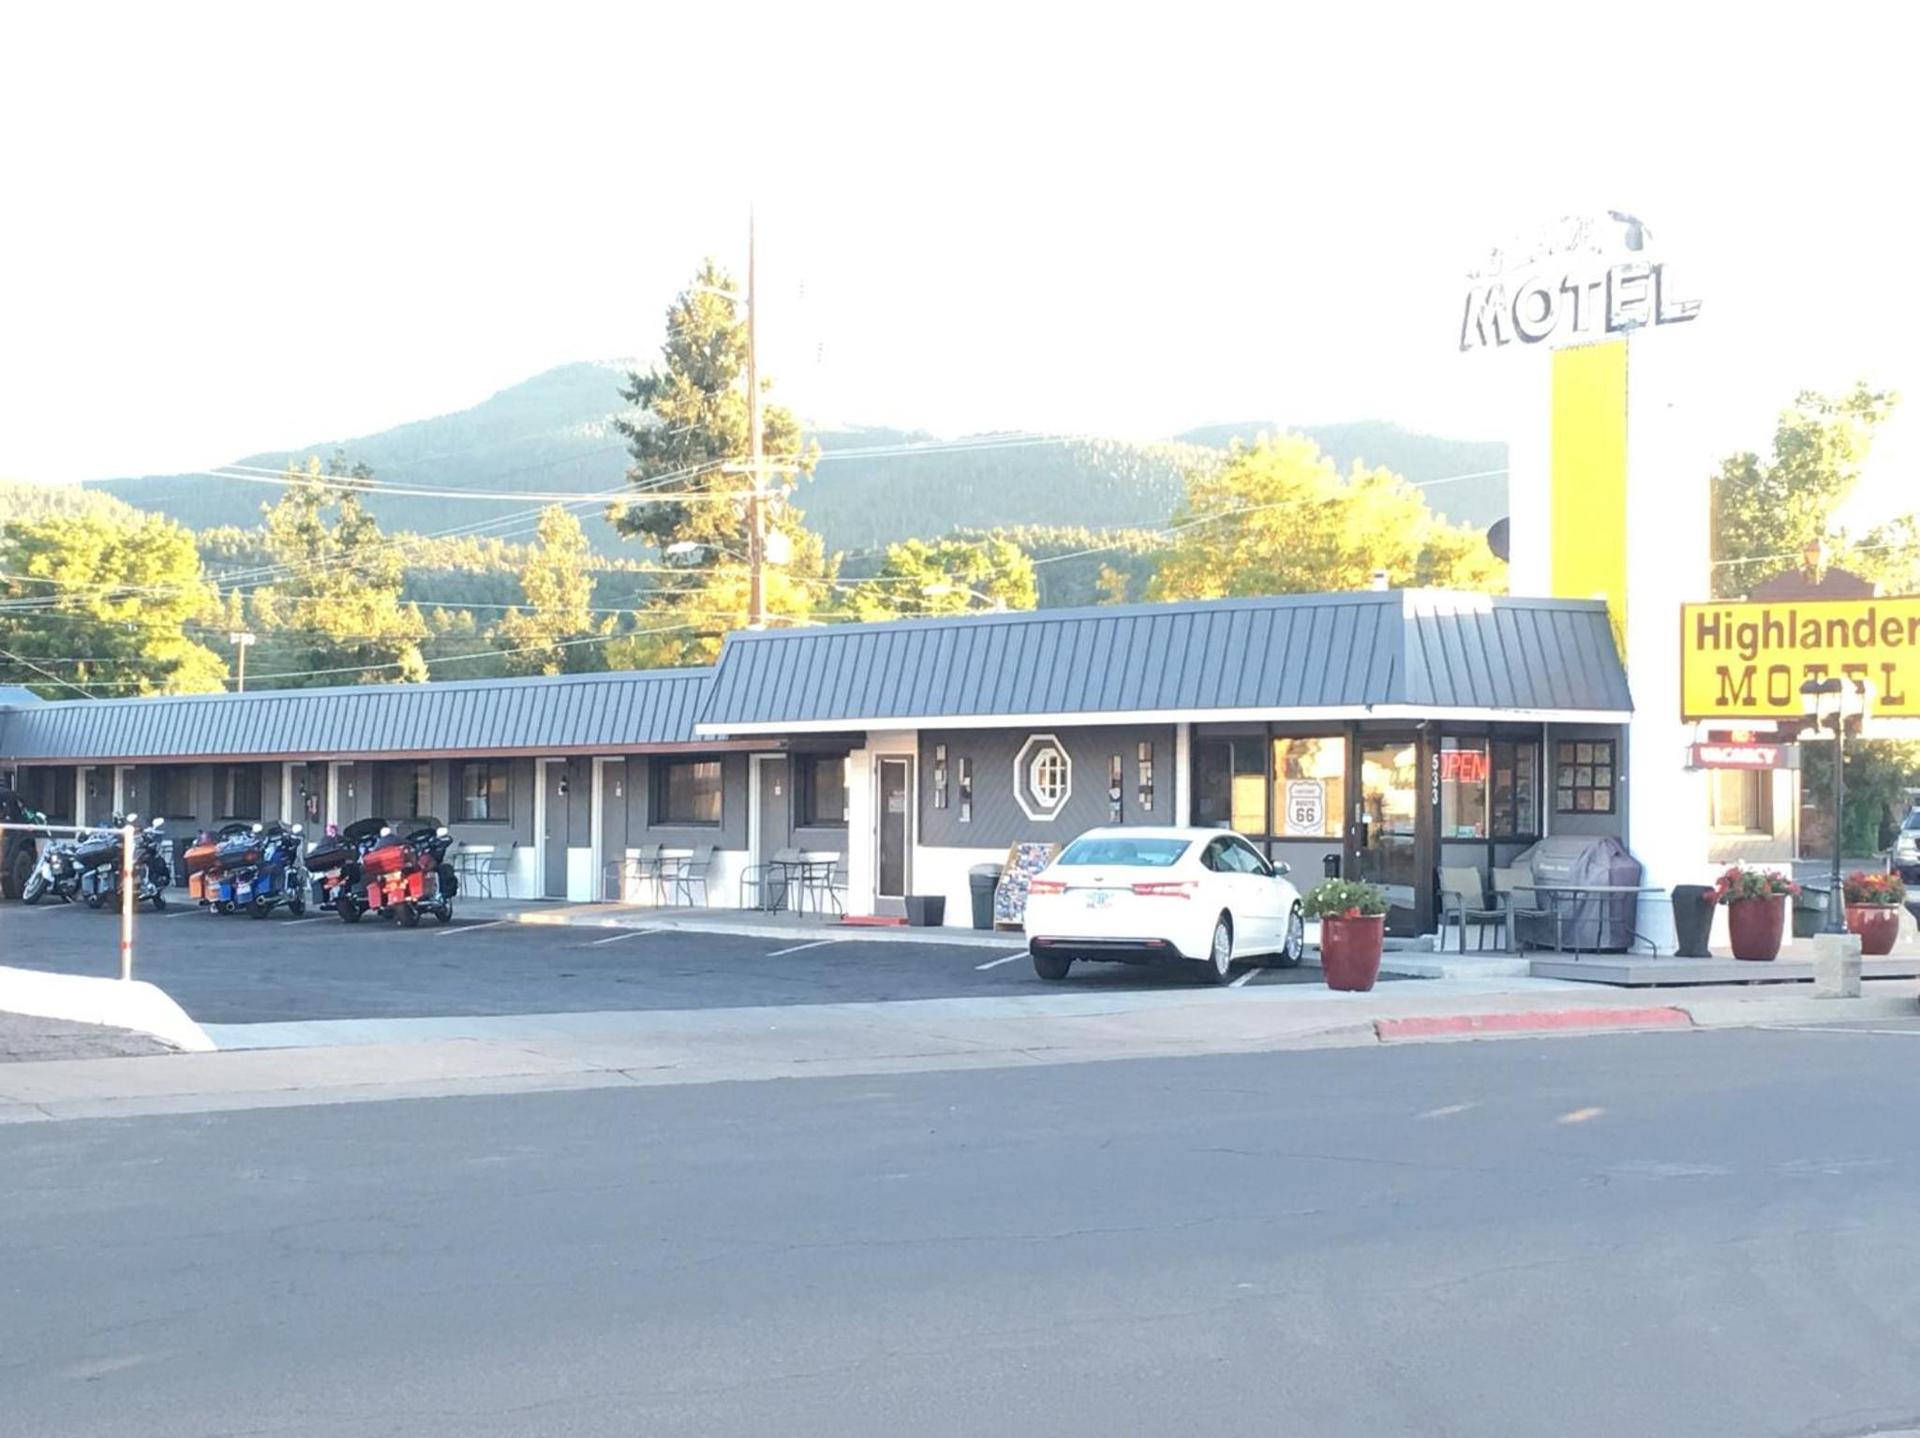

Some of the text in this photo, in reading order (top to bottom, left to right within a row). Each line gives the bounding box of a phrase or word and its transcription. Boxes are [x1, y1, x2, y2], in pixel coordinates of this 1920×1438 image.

[1459, 260, 1703, 352] MOTEL
[1696, 607, 1920, 661] Highlander
[1296, 807, 1315, 823] 66
